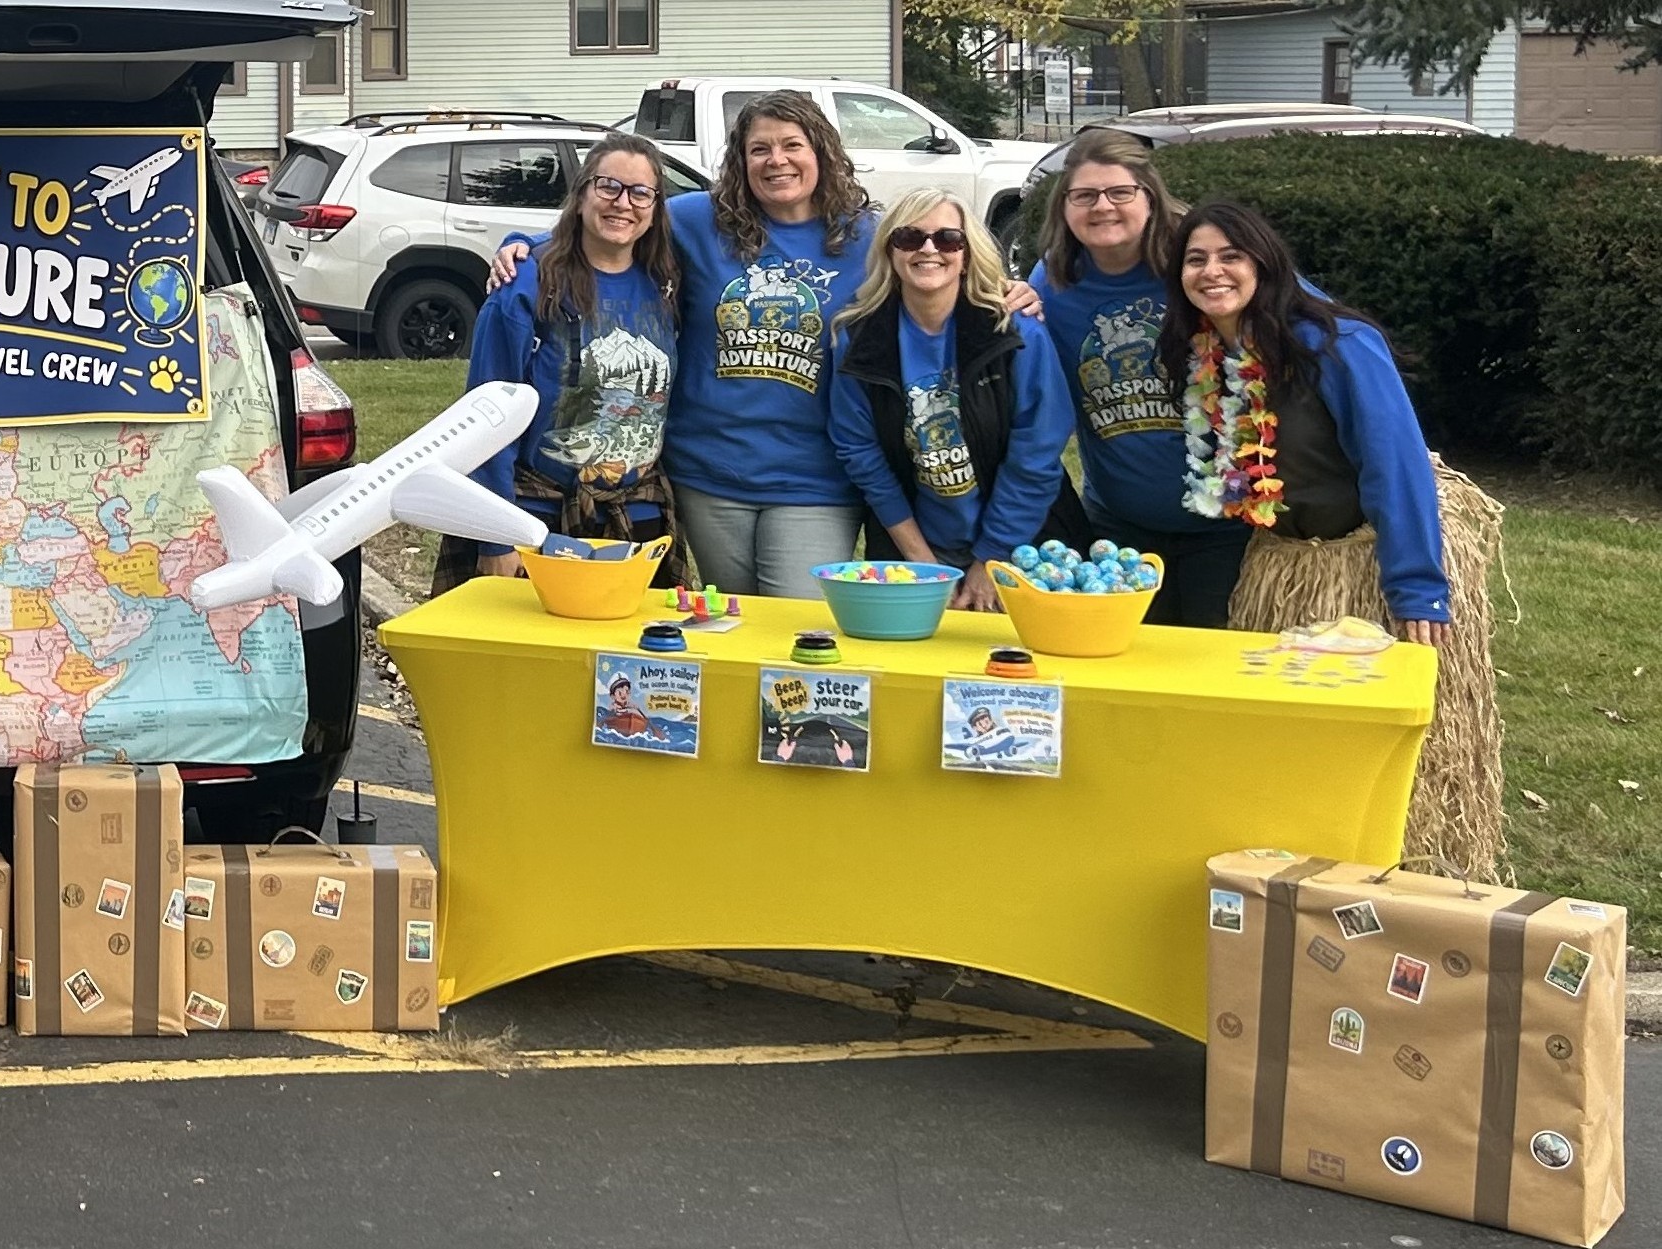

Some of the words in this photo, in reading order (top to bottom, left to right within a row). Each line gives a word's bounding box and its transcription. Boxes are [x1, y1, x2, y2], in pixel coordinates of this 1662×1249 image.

[8, 172, 71, 236] TO
[724, 329, 816, 353] PASSPORT
[42, 351, 118, 387] CREW
[719, 349, 821, 380] ADVENTURE
[1091, 378, 1174, 406] PASSPOR
[639, 665, 668, 680] Ahoy,
[816, 678, 859, 697] steer
[960, 687, 1006, 699] Welcome
[779, 690, 808, 709] beep!
[813, 696, 841, 711] your
[843, 698, 863, 711] car
